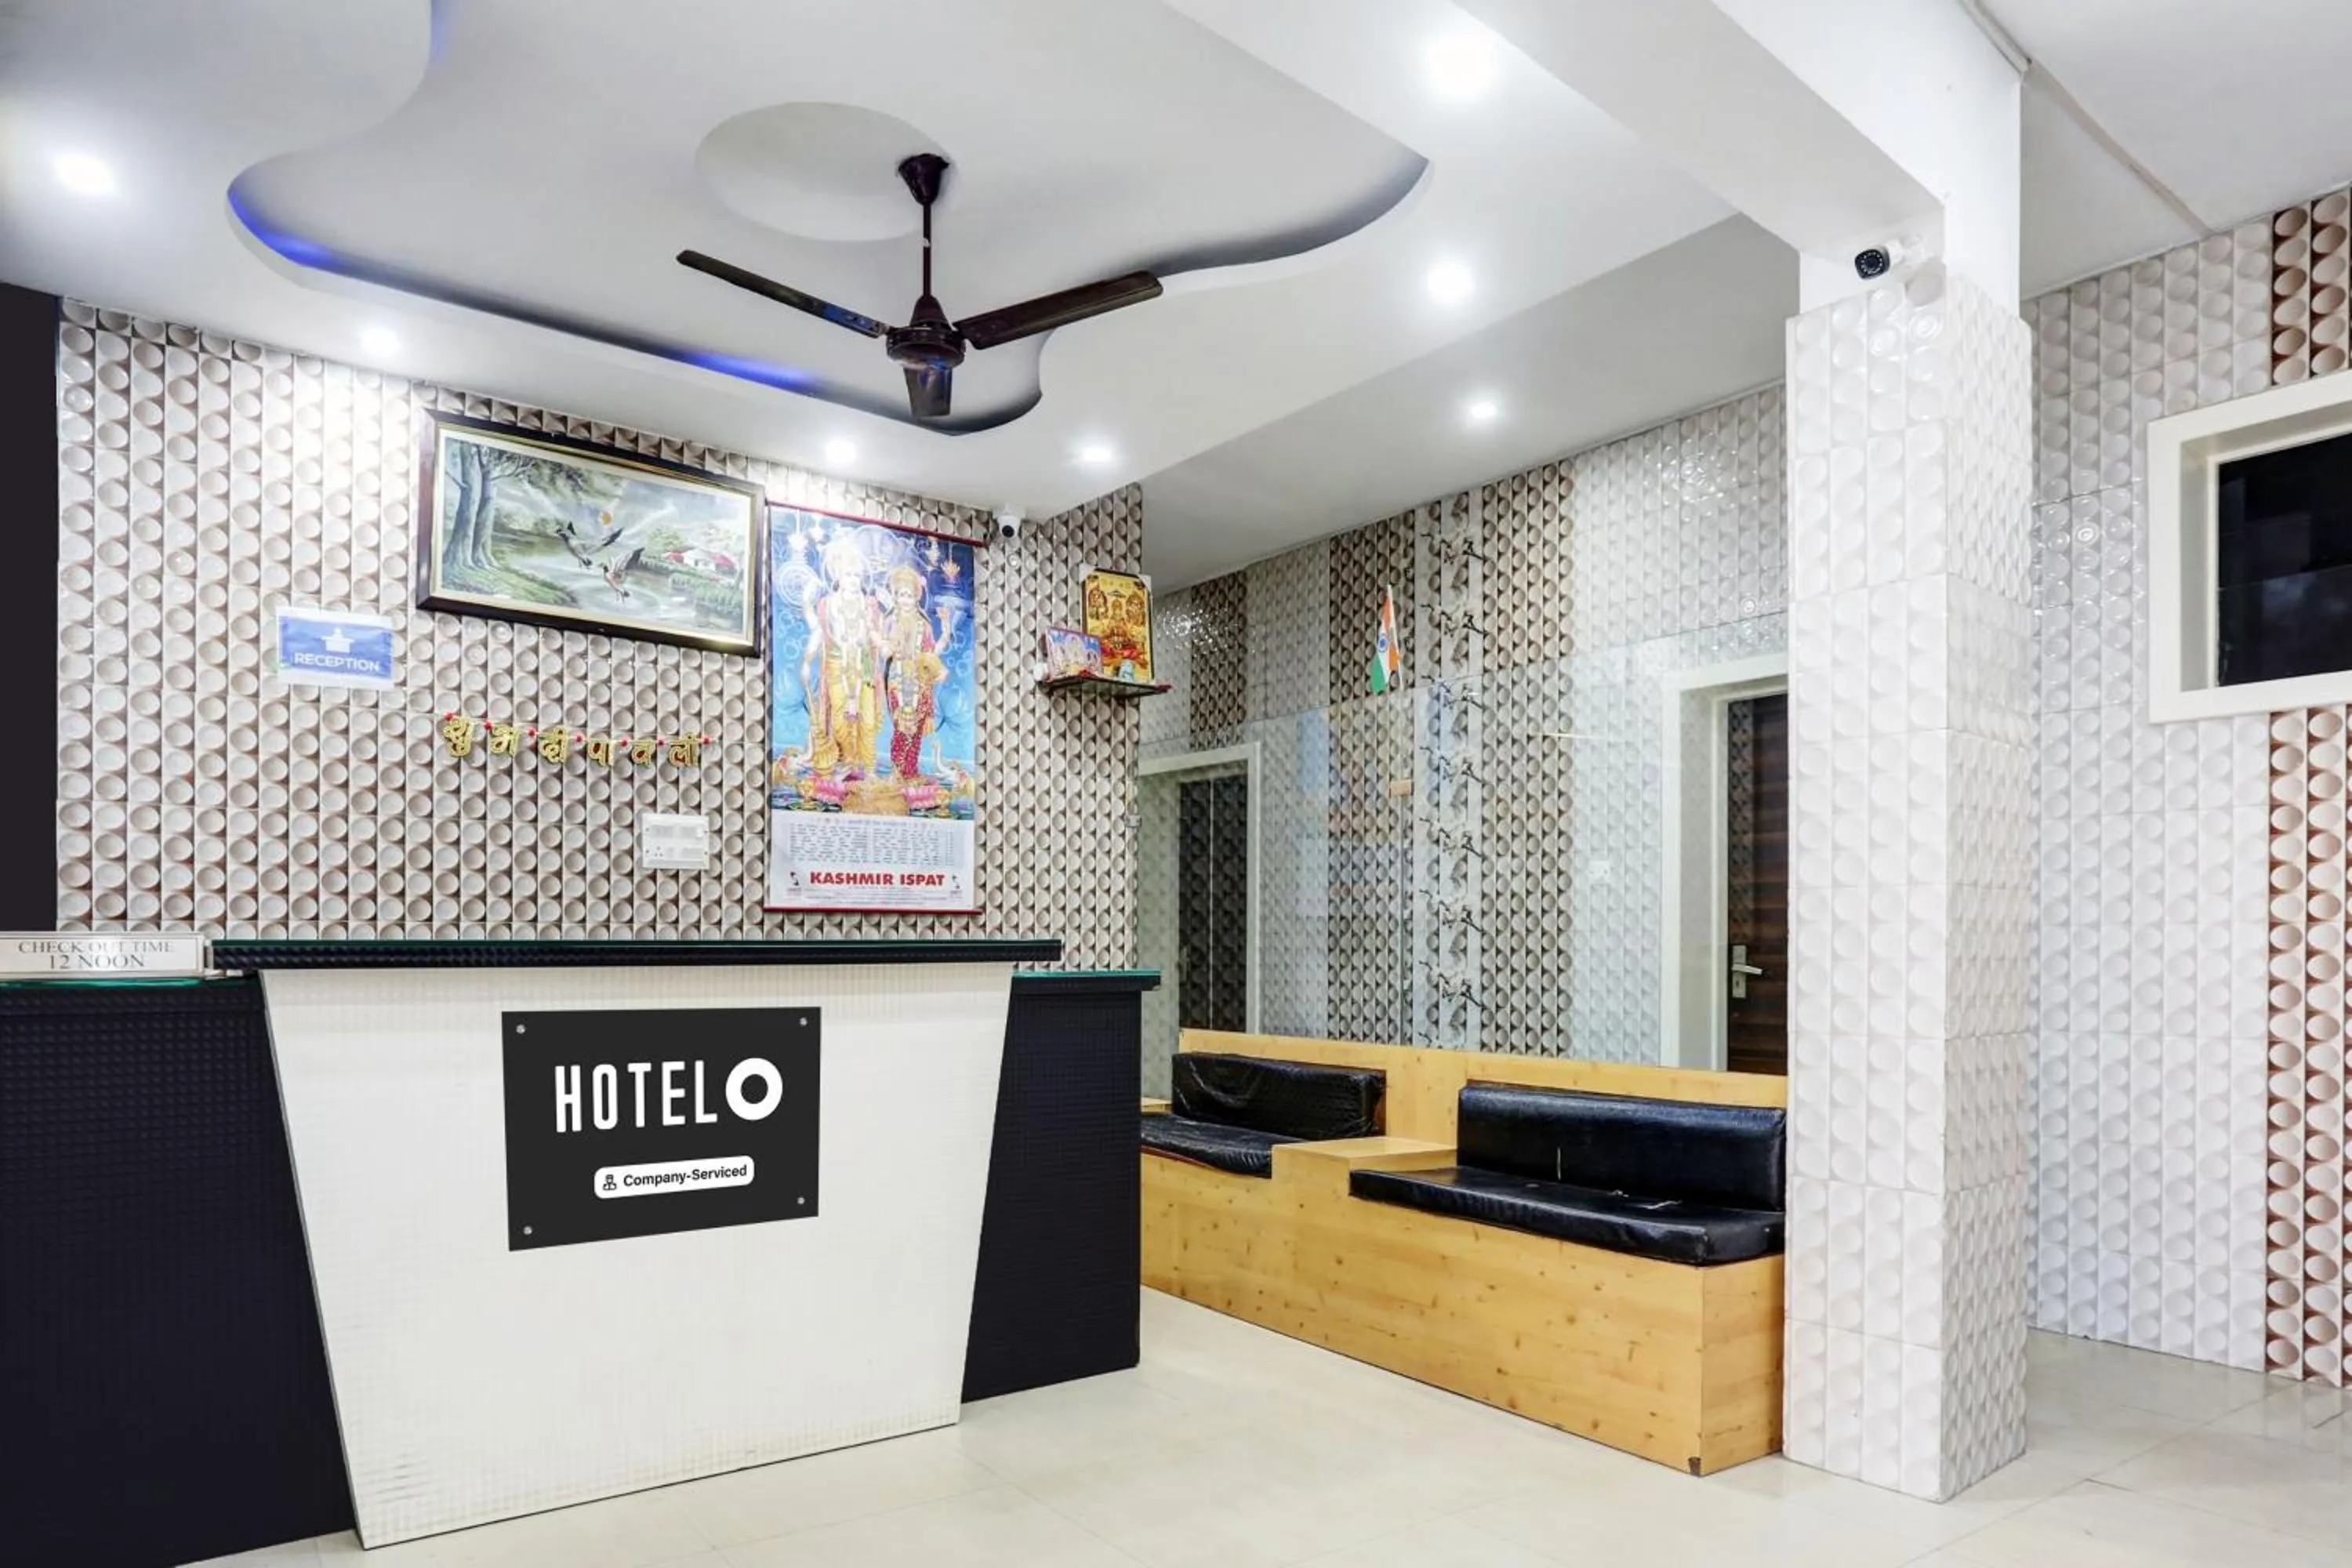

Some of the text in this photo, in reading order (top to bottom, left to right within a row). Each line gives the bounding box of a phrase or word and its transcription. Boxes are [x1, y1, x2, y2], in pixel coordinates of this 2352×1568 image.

[294, 652, 380, 672] RECEPTION
[810, 871, 946, 886] KASHMIR ISPAT
[18, 941, 175, 953] CHECK OUT TIME
[49, 954, 146, 970] 12 NOON
[554, 1060, 718, 1133] HOTEL
[623, 1165, 748, 1188] Company-Serviced
